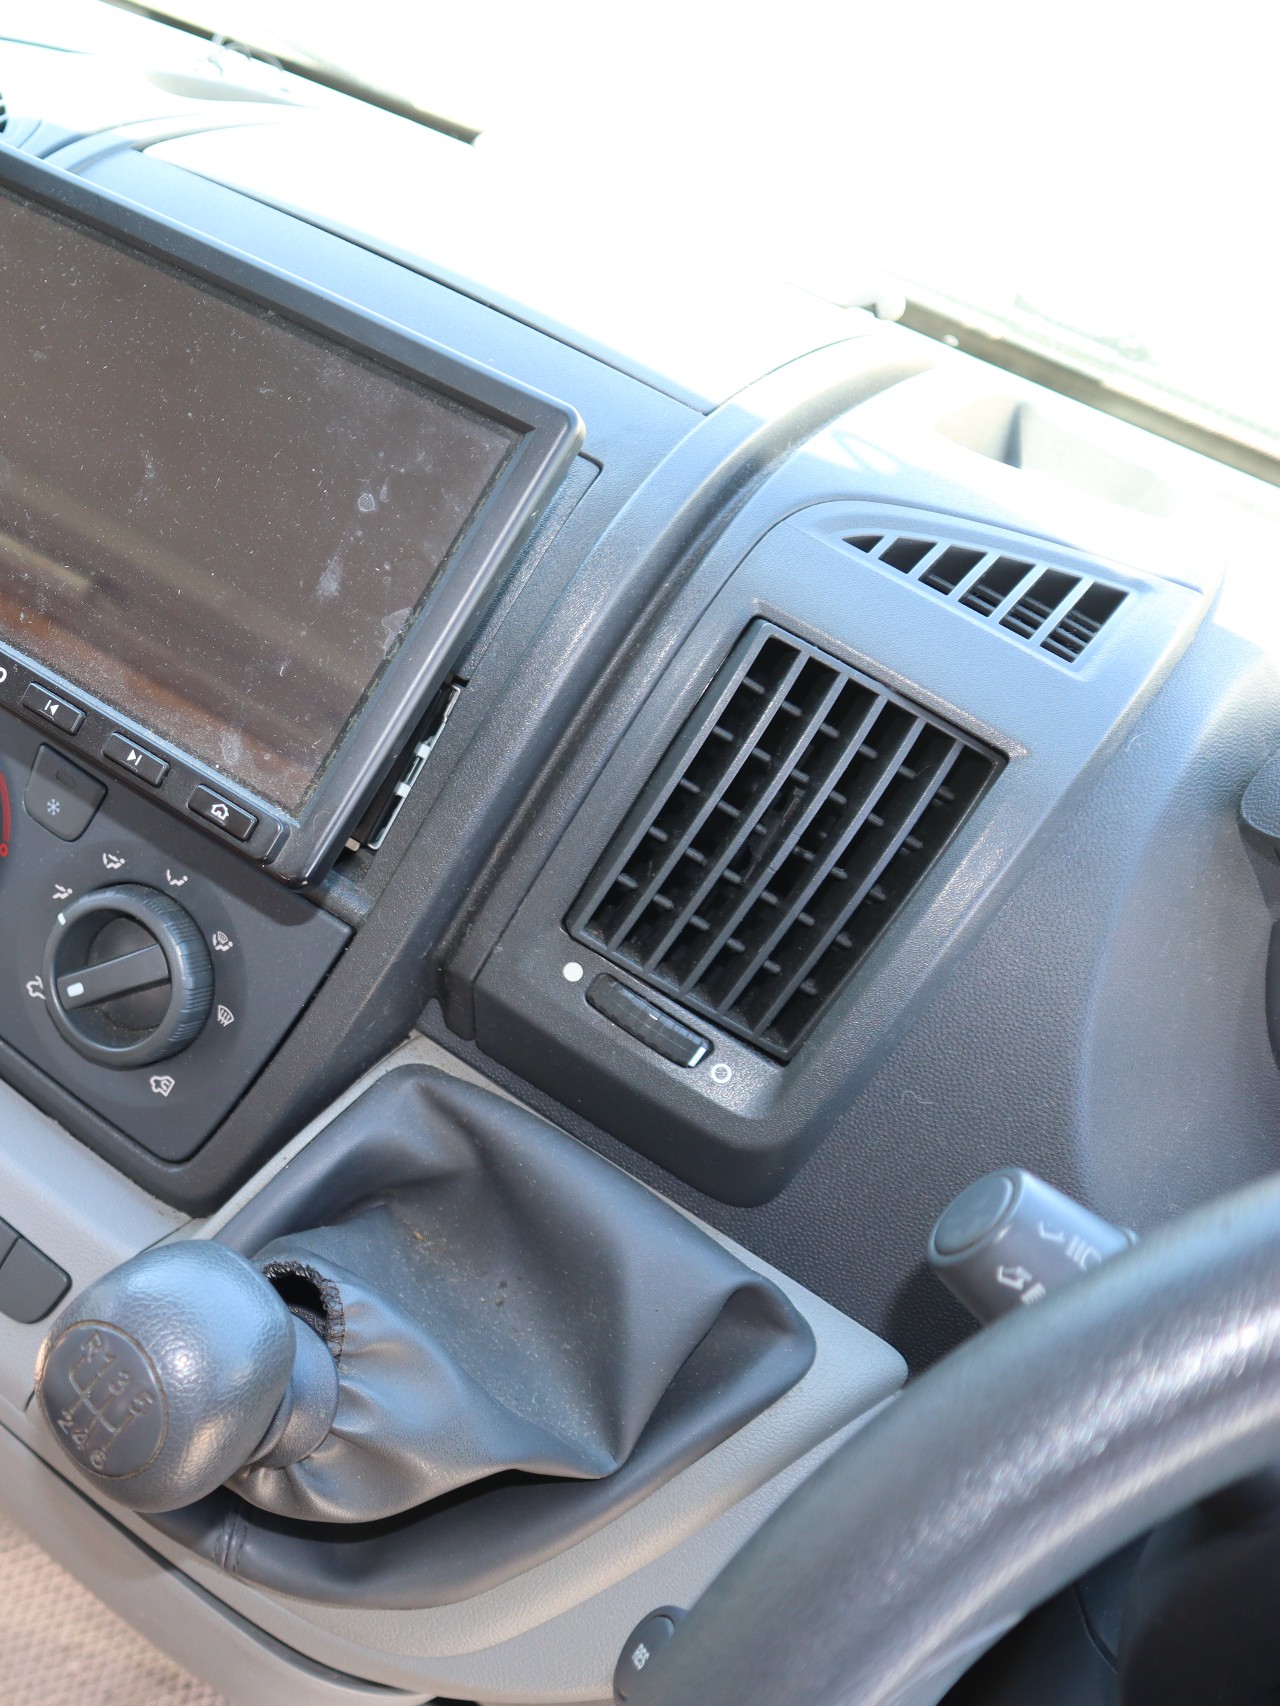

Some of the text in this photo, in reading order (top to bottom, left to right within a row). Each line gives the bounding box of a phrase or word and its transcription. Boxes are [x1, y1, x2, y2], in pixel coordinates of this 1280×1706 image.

[80, 1329, 103, 1363] R
[108, 1371, 132, 1396] 3
[128, 1390, 154, 1417] 5
[57, 1411, 75, 1435] 2
[89, 1448, 107, 1471] 6
[631, 1642, 650, 1671] RES
